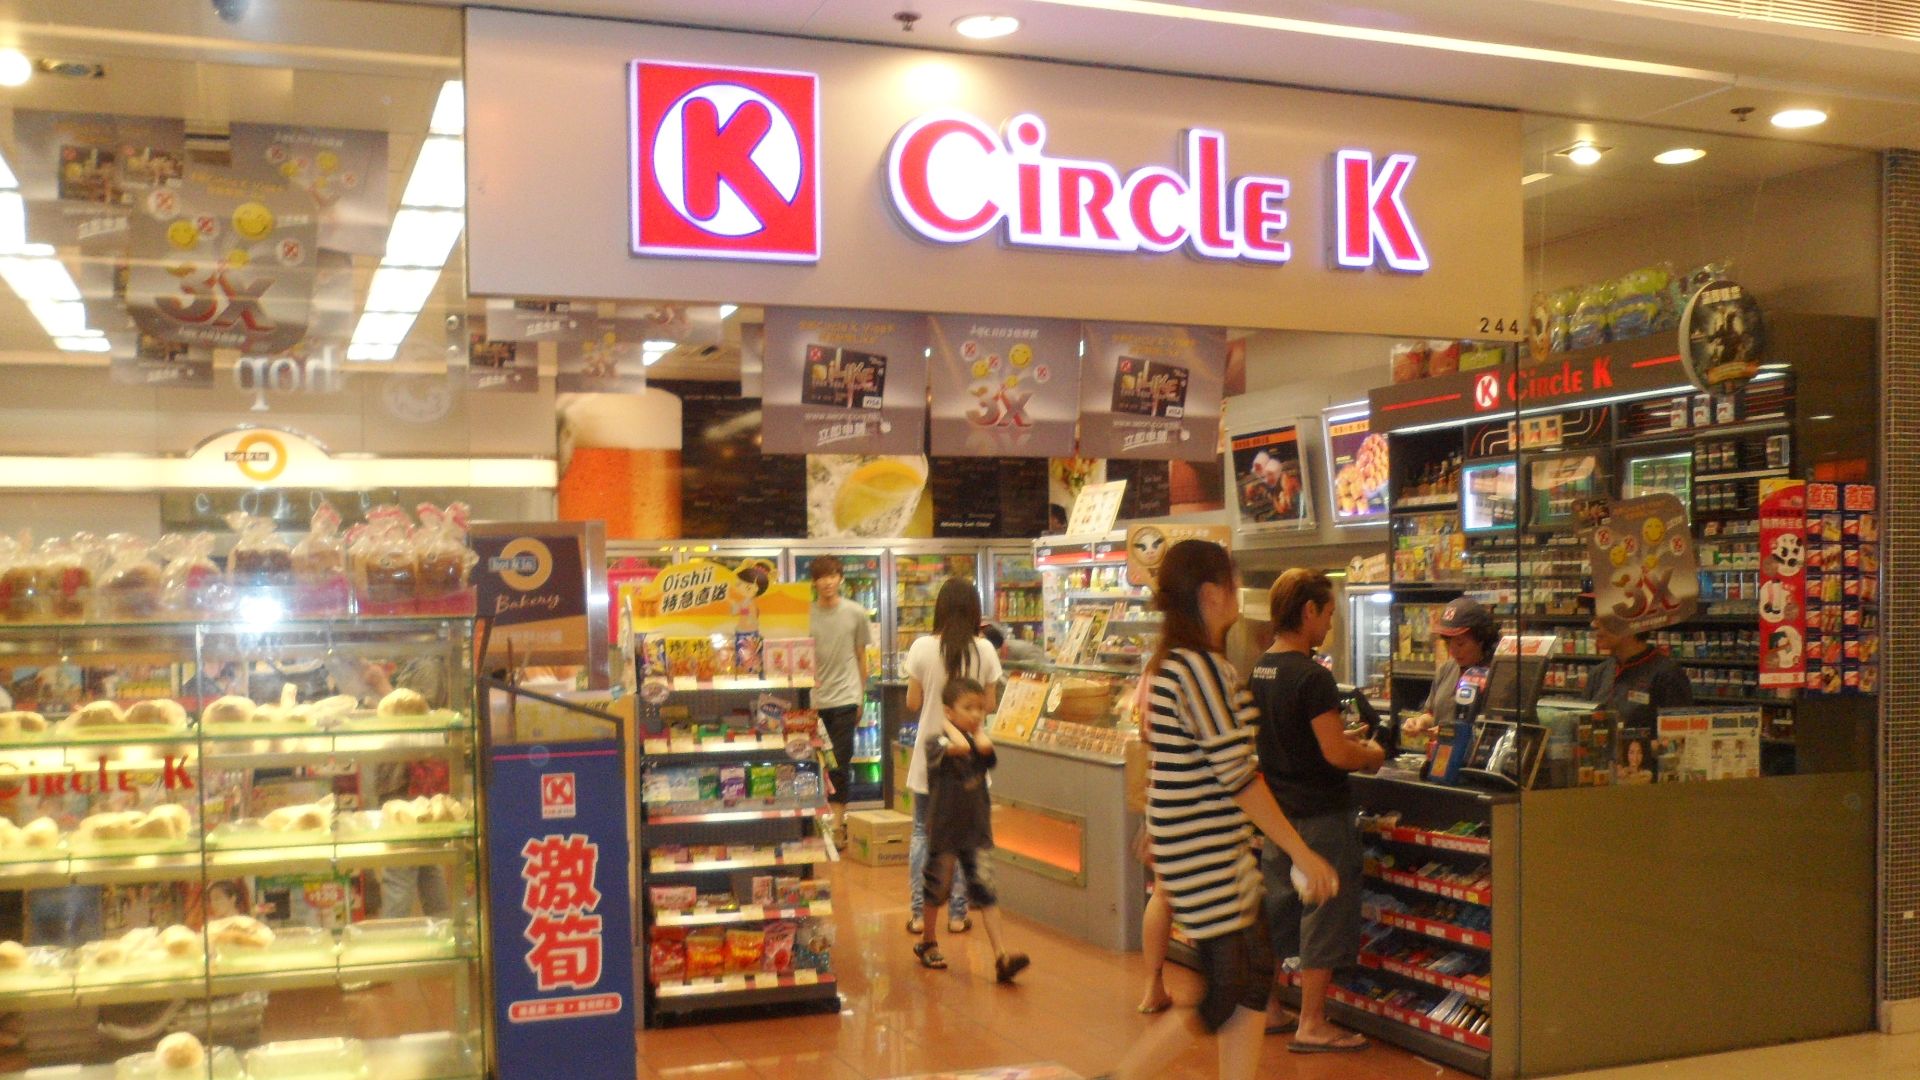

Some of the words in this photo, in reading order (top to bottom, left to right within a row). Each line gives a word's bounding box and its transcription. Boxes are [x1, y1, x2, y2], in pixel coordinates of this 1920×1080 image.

[680, 95, 796, 231] K
[1336, 149, 1429, 271] K
[1480, 317, 1519, 335] 244
[1593, 356, 1614, 390] K
[966, 382, 1034, 428] 3X
[663, 566, 714, 593] Oishii
[494, 593, 560, 614] Bakery
[164, 754, 194, 790] K
